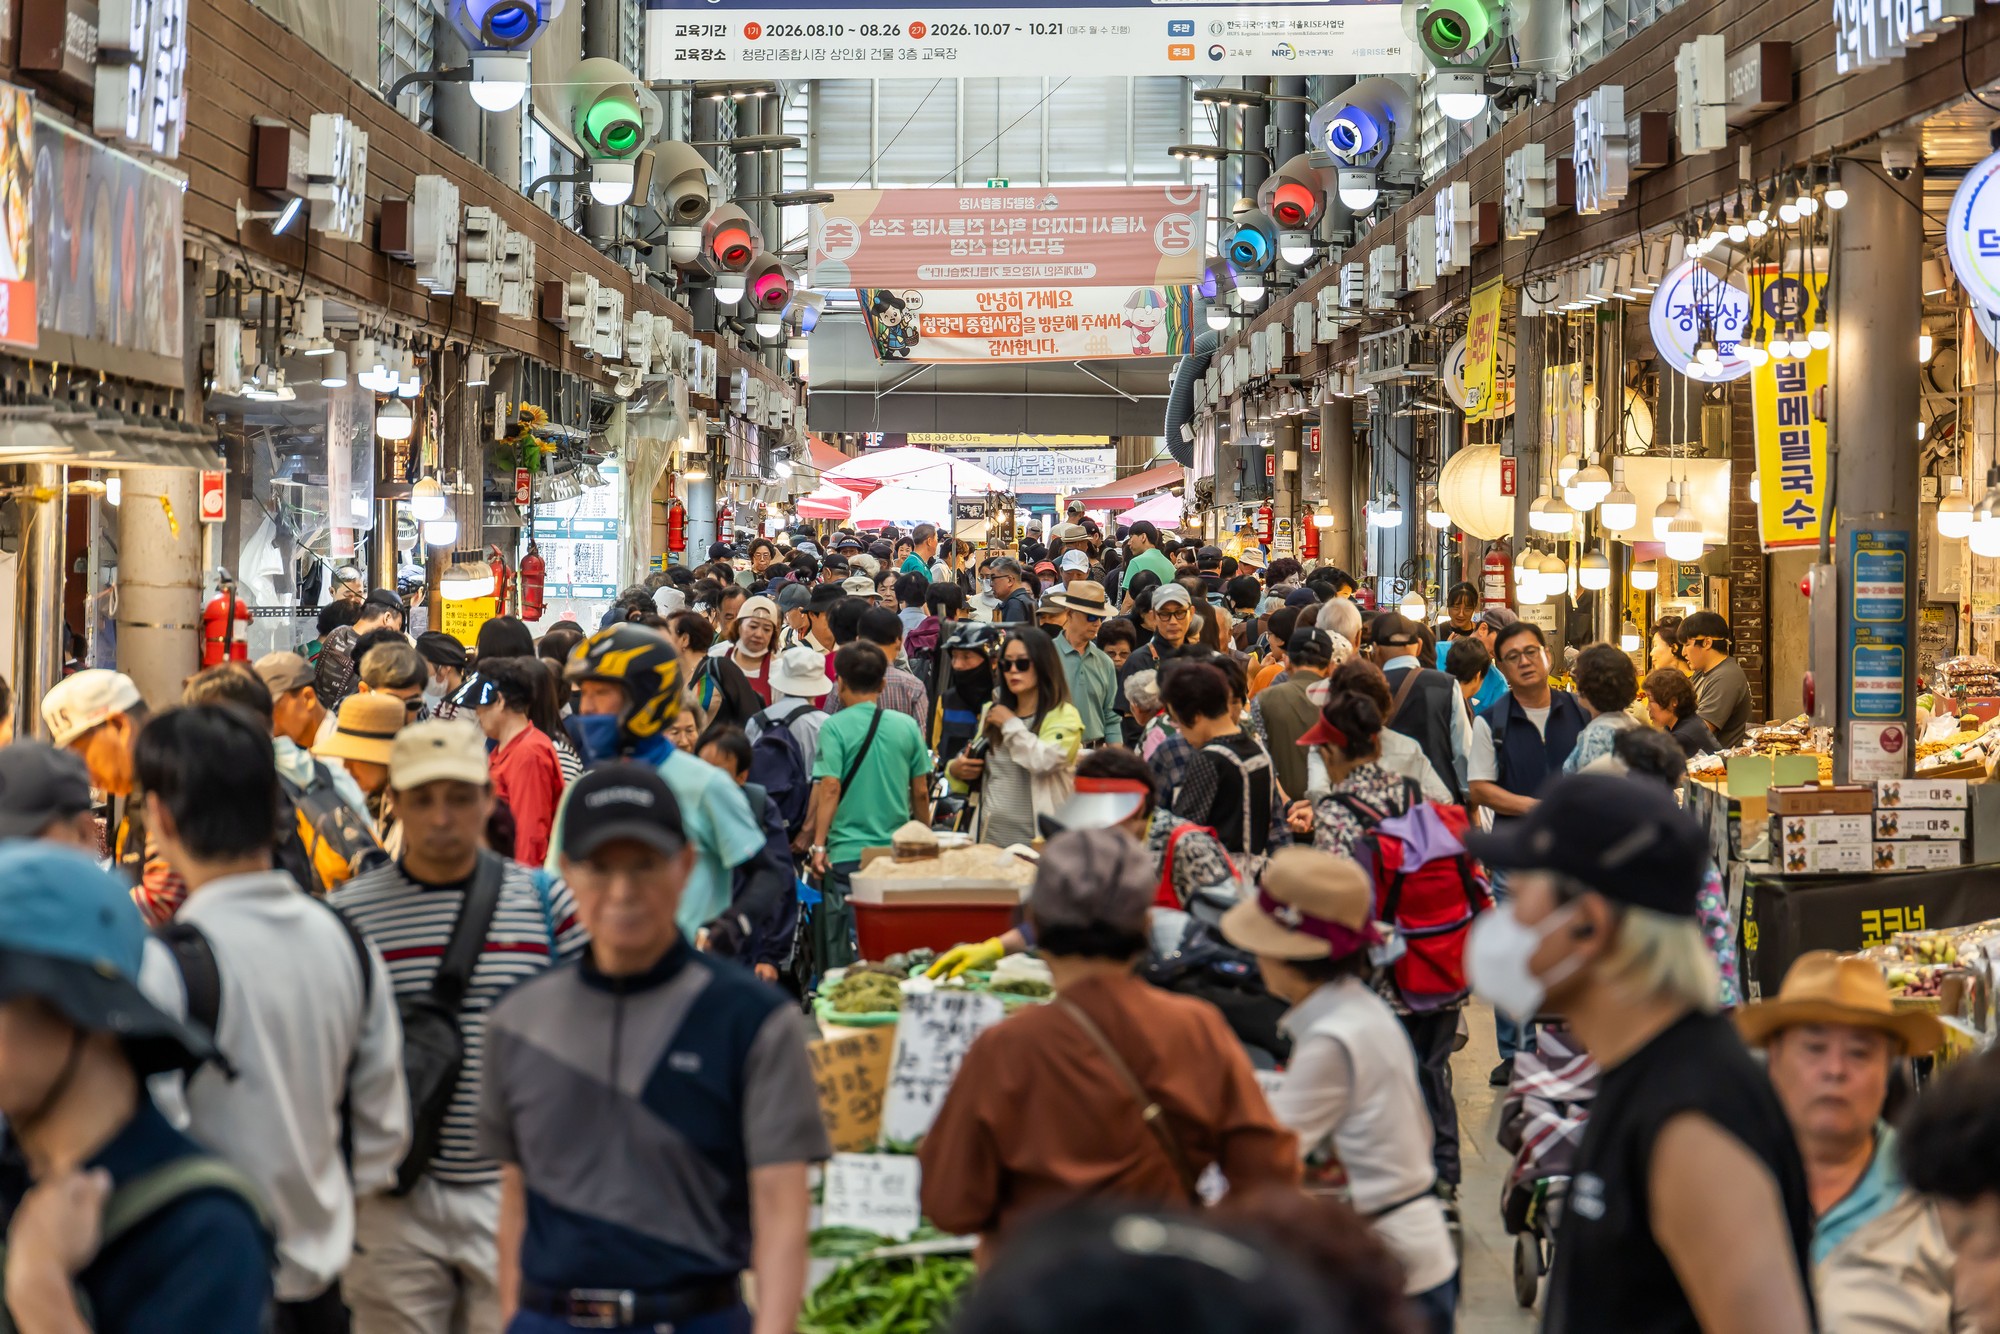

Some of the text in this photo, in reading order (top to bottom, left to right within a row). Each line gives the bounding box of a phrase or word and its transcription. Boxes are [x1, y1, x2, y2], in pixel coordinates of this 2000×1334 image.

[675, 24, 727, 37] 교육기간
[747, 26, 760, 35] 1기
[766, 24, 844, 37] 2026.08.10
[860, 24, 900, 37] 08.26
[911, 26, 924, 35] 2기
[1029, 23, 1063, 35] 10.21
[1172, 23, 1190, 33] 주관
[1227, 19, 1344, 30] 한국외국어대학교 서울RISE사업단
[674, 48, 727, 61] 교육장소
[742, 48, 957, 61] 청량리종합시장 상인회 건물 3층 교육장
[1172, 47, 1190, 57] 주최
[1229, 48, 1253, 57] 교육부
[1272, 49, 1291, 57] NRF
[1299, 48, 1334, 57] 한국연구재단
[1352, 47, 1401, 57] 서울RISE센터
[976, 290, 1074, 312] 안녕히 가세요
[922, 317, 964, 334] 청량리
[1038, 314, 1079, 332] 방문해
[1081, 312, 1121, 331] 주셔서
[988, 337, 1059, 355] 감사합니다.
[1929, 788, 1952, 800] 대추
[1927, 819, 1950, 831] 대추
